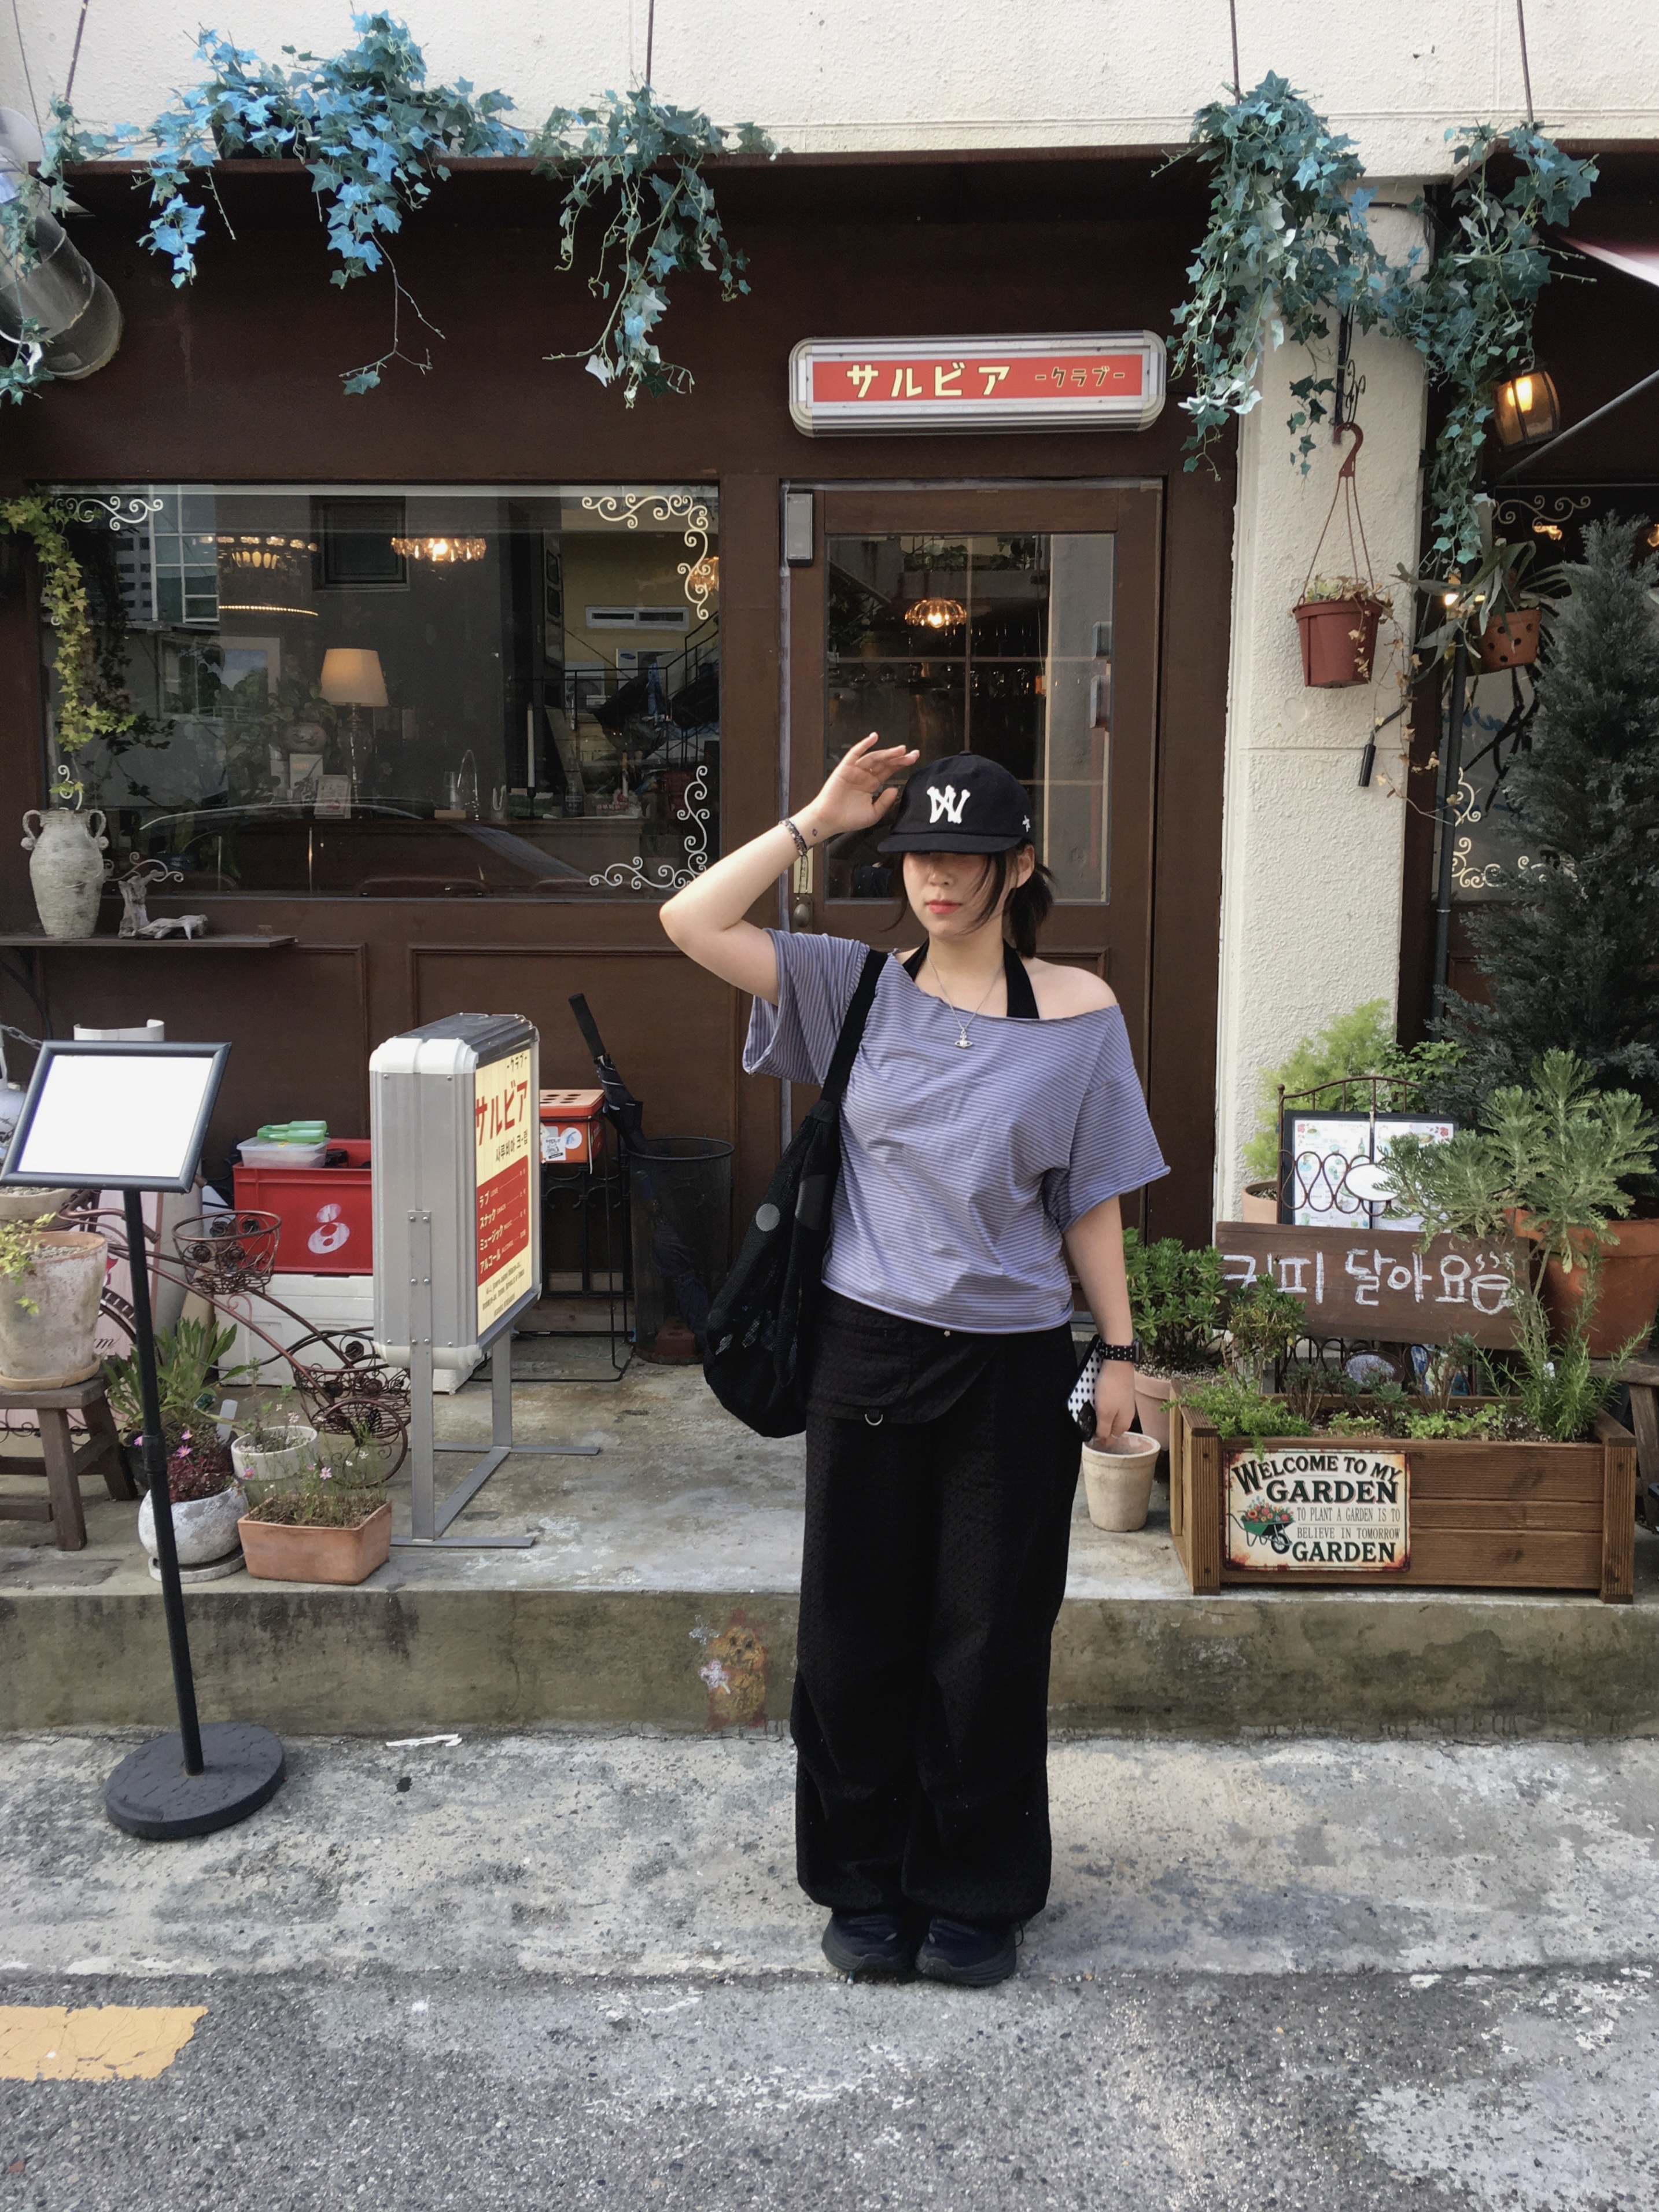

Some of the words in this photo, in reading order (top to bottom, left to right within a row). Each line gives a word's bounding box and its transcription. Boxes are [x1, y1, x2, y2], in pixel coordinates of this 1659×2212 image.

[847, 362, 1011, 398] サルビア
[475, 1080, 528, 1146] サルビア
[1345, 1248, 1471, 1306] 달아요
[1232, 1455, 1339, 1496] WELCOME
[1344, 1456, 1367, 1474] TO
[1370, 1462, 1404, 1483] MY
[1266, 1479, 1399, 1504] GARDEN
[1297, 1507, 1306, 1521] TO
[1310, 1507, 1333, 1521] PLANT
[1337, 1507, 1342, 1521] A
[1345, 1507, 1373, 1522] GARDEN
[1378, 1507, 1386, 1522] IS
[1392, 1507, 1400, 1522] TO
[1297, 1527, 1335, 1539] BELIEVE
[1341, 1527, 1351, 1539] IN
[1358, 1528, 1400, 1540] TOMORROW
[1292, 1541, 1396, 1562] GARDEN
